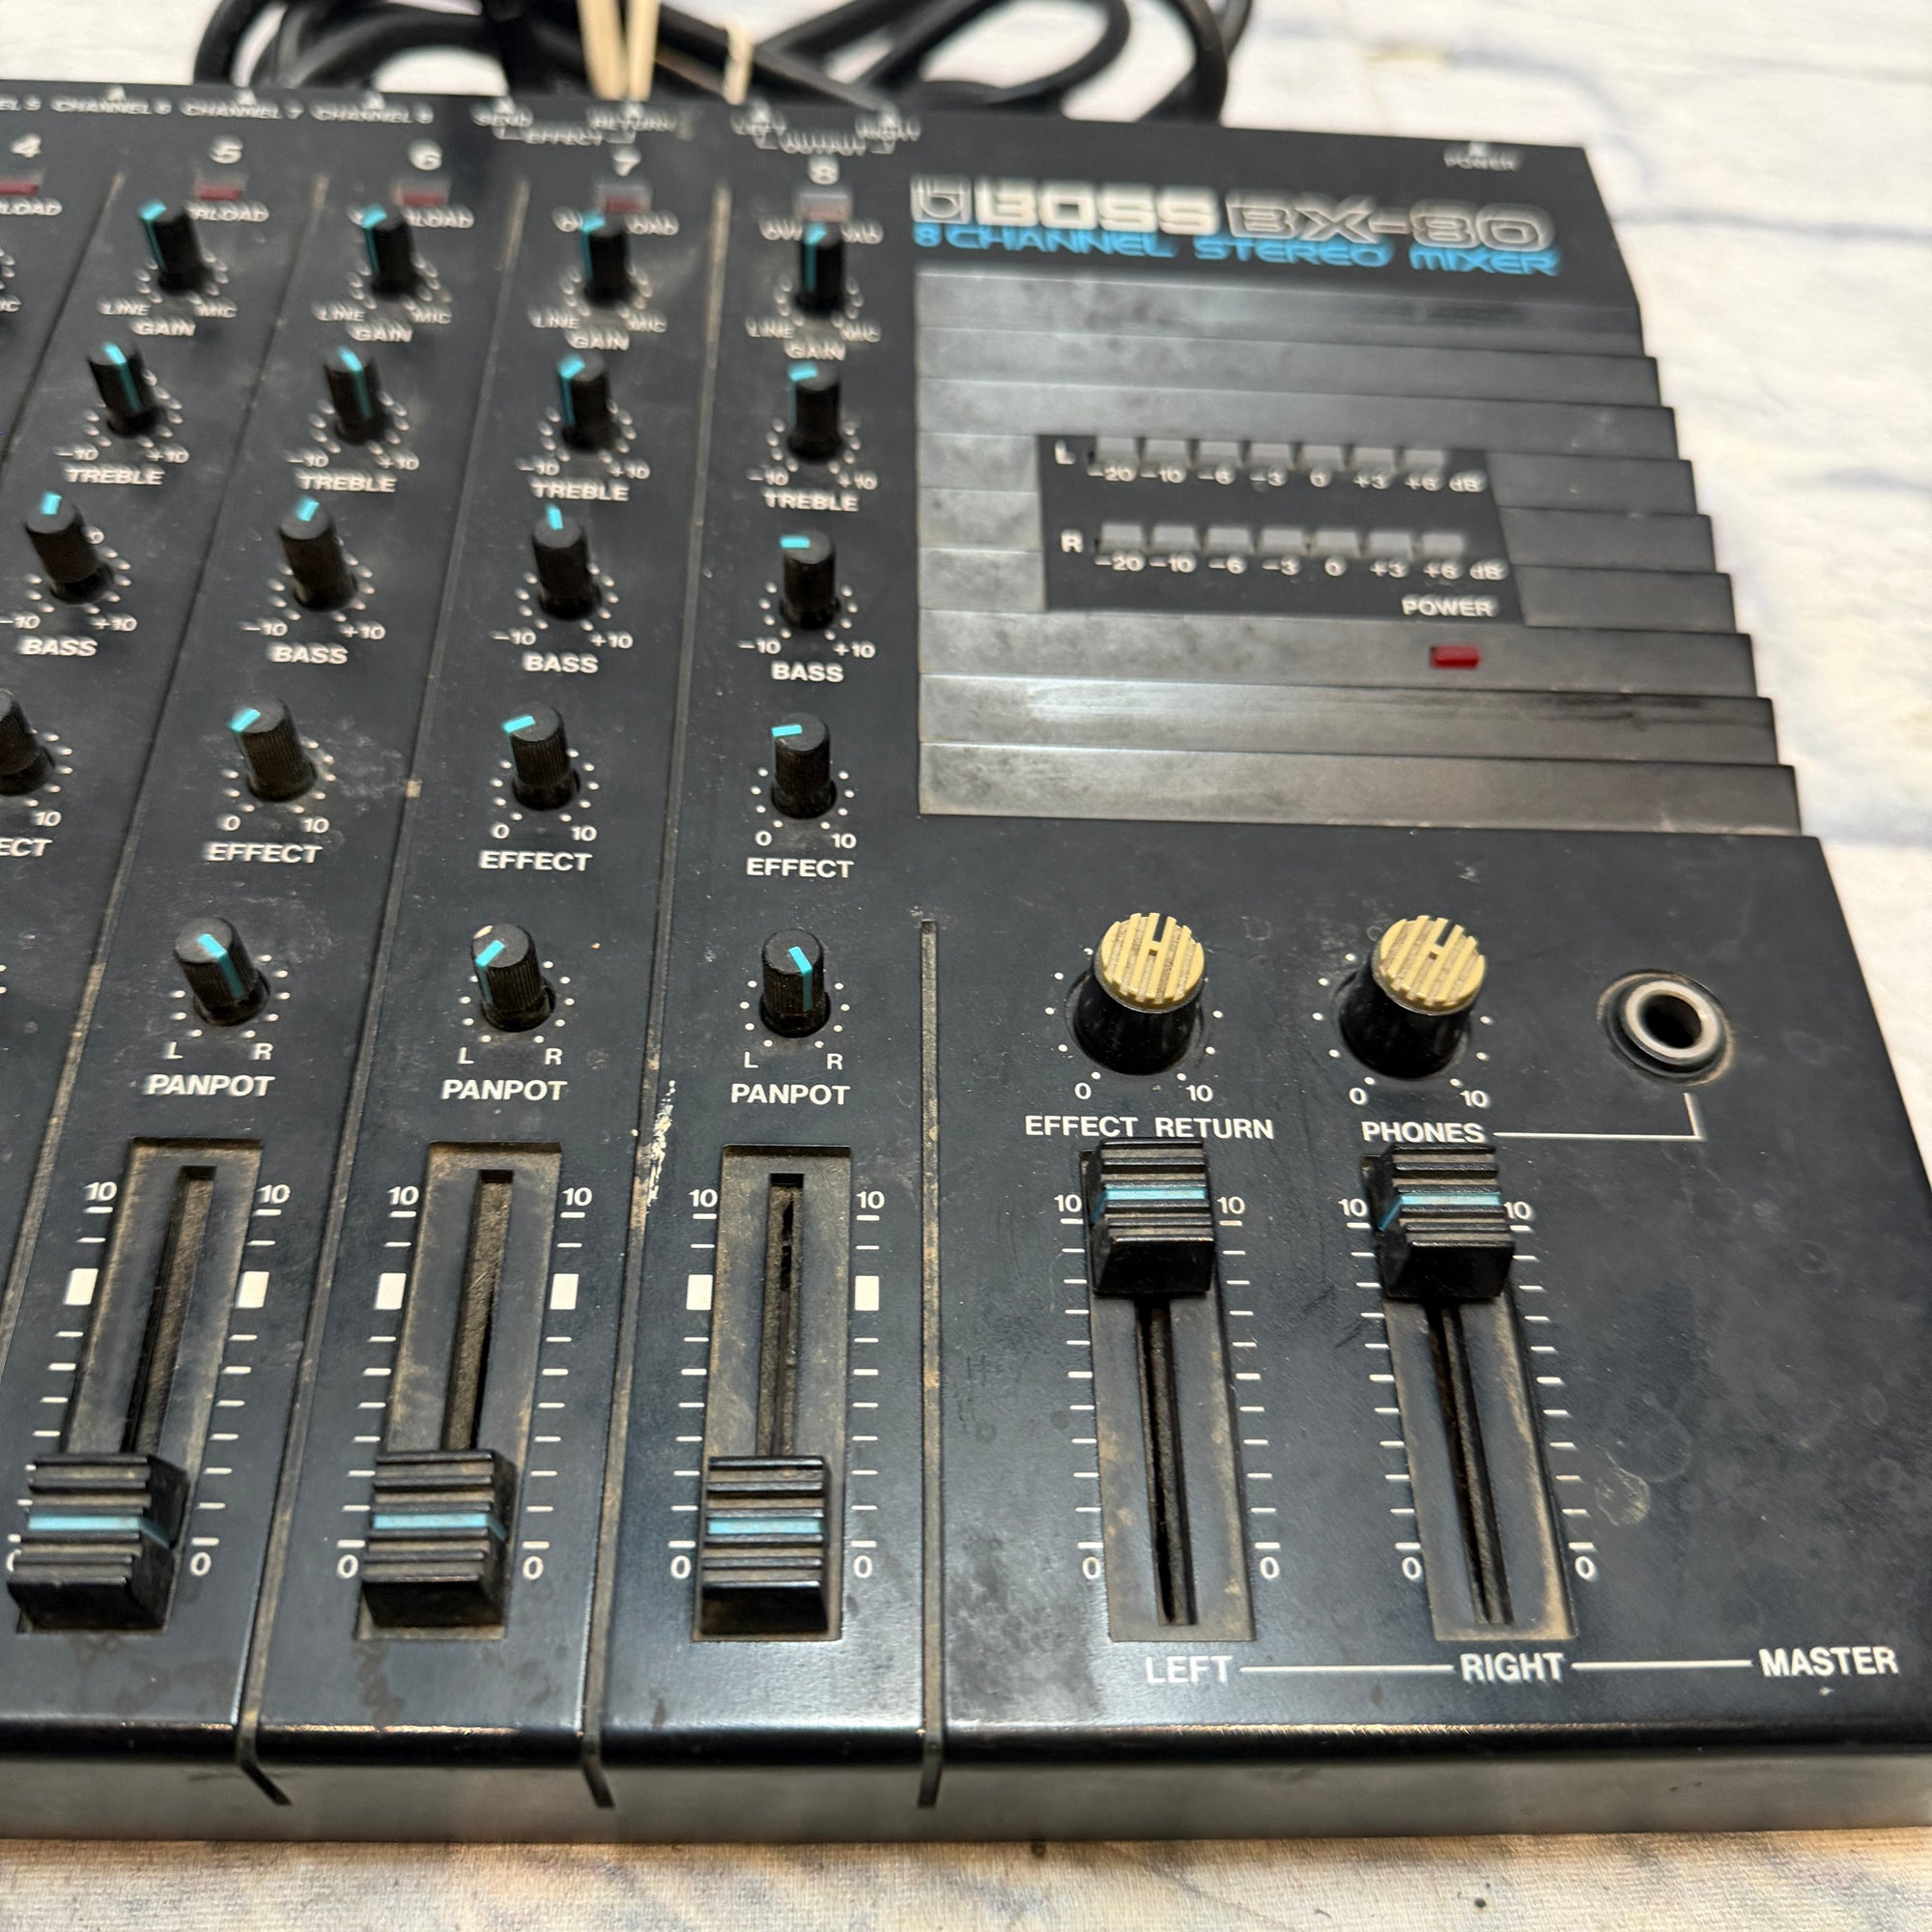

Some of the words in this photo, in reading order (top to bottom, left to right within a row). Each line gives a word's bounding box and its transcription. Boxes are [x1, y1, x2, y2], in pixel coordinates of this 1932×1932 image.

[51, 98, 152, 114] CHANNEL
[180, 100, 282, 119] CHANNEL
[309, 101, 413, 123] CHANNEL
[11, 133, 42, 157] 4
[210, 137, 242, 163] 5
[409, 140, 442, 170] 6
[612, 147, 640, 176] 7
[809, 156, 839, 185] 8
[975, 180, 1219, 235] BOSS
[1225, 191, 1555, 251] BX-80
[913, 221, 942, 246] 8
[945, 223, 1178, 258] CHANNEL
[1193, 235, 1394, 268] STEREO
[1409, 244, 1561, 275] MIXER
[99, 299, 152, 317] LINE
[196, 299, 238, 318] MIC
[312, 303, 366, 323] LINE
[410, 306, 452, 325] MIC
[527, 307, 580, 329] LINE
[129, 316, 196, 336] GAIN
[627, 311, 668, 333] MIC
[745, 317, 795, 339] LINE
[839, 321, 881, 343] MIC
[346, 322, 412, 343] GAIN
[565, 327, 630, 351] GAIN
[783, 338, 845, 360] GAIN
[145, 444, 188, 464] +10
[376, 450, 419, 470] +10
[63, 464, 165, 485] TREBLE
[610, 460, 650, 480] +10
[1056, 441, 1074, 465] L
[1310, 469, 1332, 487] 0
[1353, 470, 1394, 490] +3
[1405, 472, 1444, 492] +6
[1450, 470, 1487, 493] dB
[296, 469, 396, 493] TREBLE
[530, 478, 629, 501] TREBLE
[837, 470, 877, 490] +10
[763, 488, 859, 511] TREBLE
[1061, 529, 1082, 553] R
[1324, 556, 1347, 577] 0
[1370, 558, 1409, 578] +3
[1423, 560, 1463, 580] +6
[1470, 558, 1509, 581] dB
[1402, 594, 1498, 618] POWER
[91, 613, 137, 632] +10
[341, 621, 385, 639] +10
[17, 636, 98, 657] BASS
[590, 632, 633, 649] +10
[833, 642, 875, 659] +10
[267, 642, 348, 665] BASS
[523, 653, 598, 674] BASS
[771, 662, 843, 683] BASS
[33, 811, 61, 827] 10
[217, 815, 241, 831] 0
[301, 817, 329, 834] 10
[491, 824, 510, 839] 0
[571, 826, 597, 842] 10
[754, 831, 772, 846] 0
[832, 834, 856, 849] 10
[0, 838, 53, 857] ECT
[202, 842, 323, 864] EFFECT
[478, 850, 592, 871] EFFECT
[746, 858, 854, 878] EFFECT
[164, 1041, 184, 1061] L
[251, 1042, 272, 1061] R
[458, 1048, 474, 1065] L
[545, 1048, 562, 1065] R
[744, 1052, 758, 1068] L
[827, 1053, 843, 1069] R
[143, 1073, 275, 1097] PANPOT
[441, 1079, 567, 1101] PANPOT
[731, 1083, 850, 1105] PANPOT
[1074, 1083, 1092, 1100] 0
[1186, 1085, 1213, 1102] 10
[1349, 1088, 1366, 1105] 0
[1461, 1090, 1489, 1108] 10
[1025, 1116, 1138, 1138] EFFECT
[1155, 1117, 1274, 1140] RETURN
[1361, 1121, 1485, 1144] PHONES
[85, 1181, 117, 1201] 10
[258, 1184, 290, 1204] 10
[388, 1186, 418, 1206] 10
[562, 1186, 591, 1206] 10
[690, 1188, 717, 1208] 10
[856, 1191, 884, 1209] 10
[1054, 1195, 1082, 1213] 10
[1217, 1197, 1245, 1214] 10
[1338, 1200, 1367, 1217] 10
[1504, 1202, 1532, 1220] 10
[190, 1552, 211, 1576] 0
[337, 1558, 357, 1578] 0
[523, 1558, 543, 1578] 0
[670, 1558, 690, 1578] 0
[853, 1557, 871, 1577] 0
[1082, 1557, 1100, 1580] 0
[1261, 1557, 1279, 1580] 0
[1403, 1557, 1421, 1580] 0
[1576, 1557, 1596, 1580] 0
[1146, 1655, 1232, 1686] LEFT
[1460, 1652, 1565, 1685] RIGHT
[1760, 1646, 1899, 1677] MASTER
